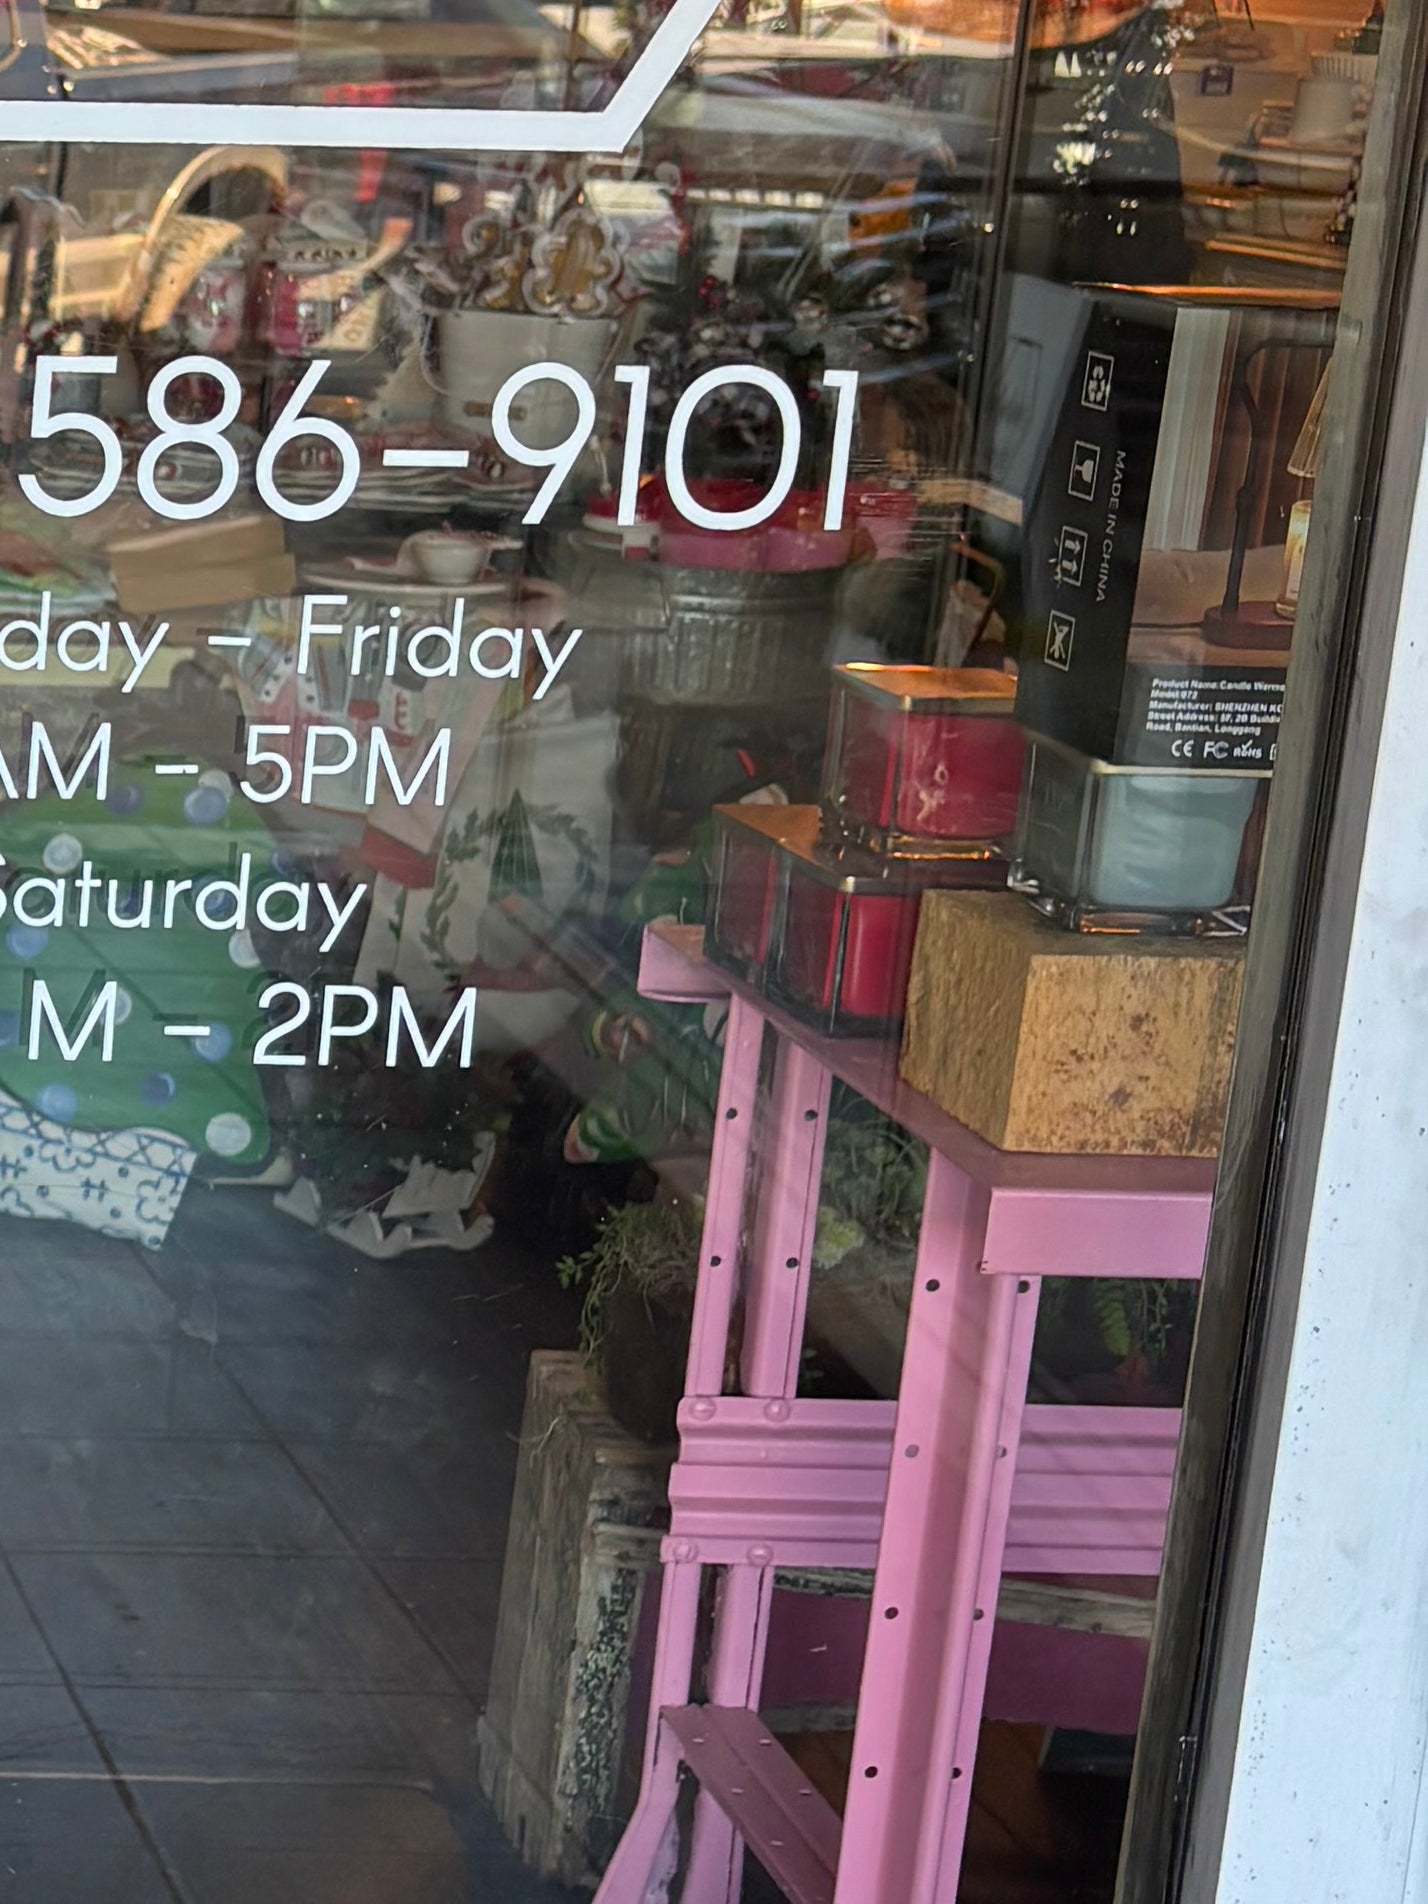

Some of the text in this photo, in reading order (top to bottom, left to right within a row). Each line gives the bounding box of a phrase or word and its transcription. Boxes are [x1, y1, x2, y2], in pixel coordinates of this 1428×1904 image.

[1096, 450, 1126, 602] MADE IN CHINA
[297, 594, 584, 699] Friday
[1152, 678, 1189, 689] Product
[241, 724, 452, 806] 5PM
[1171, 739, 1194, 758] CE
[253, 981, 477, 1069] 2PM
